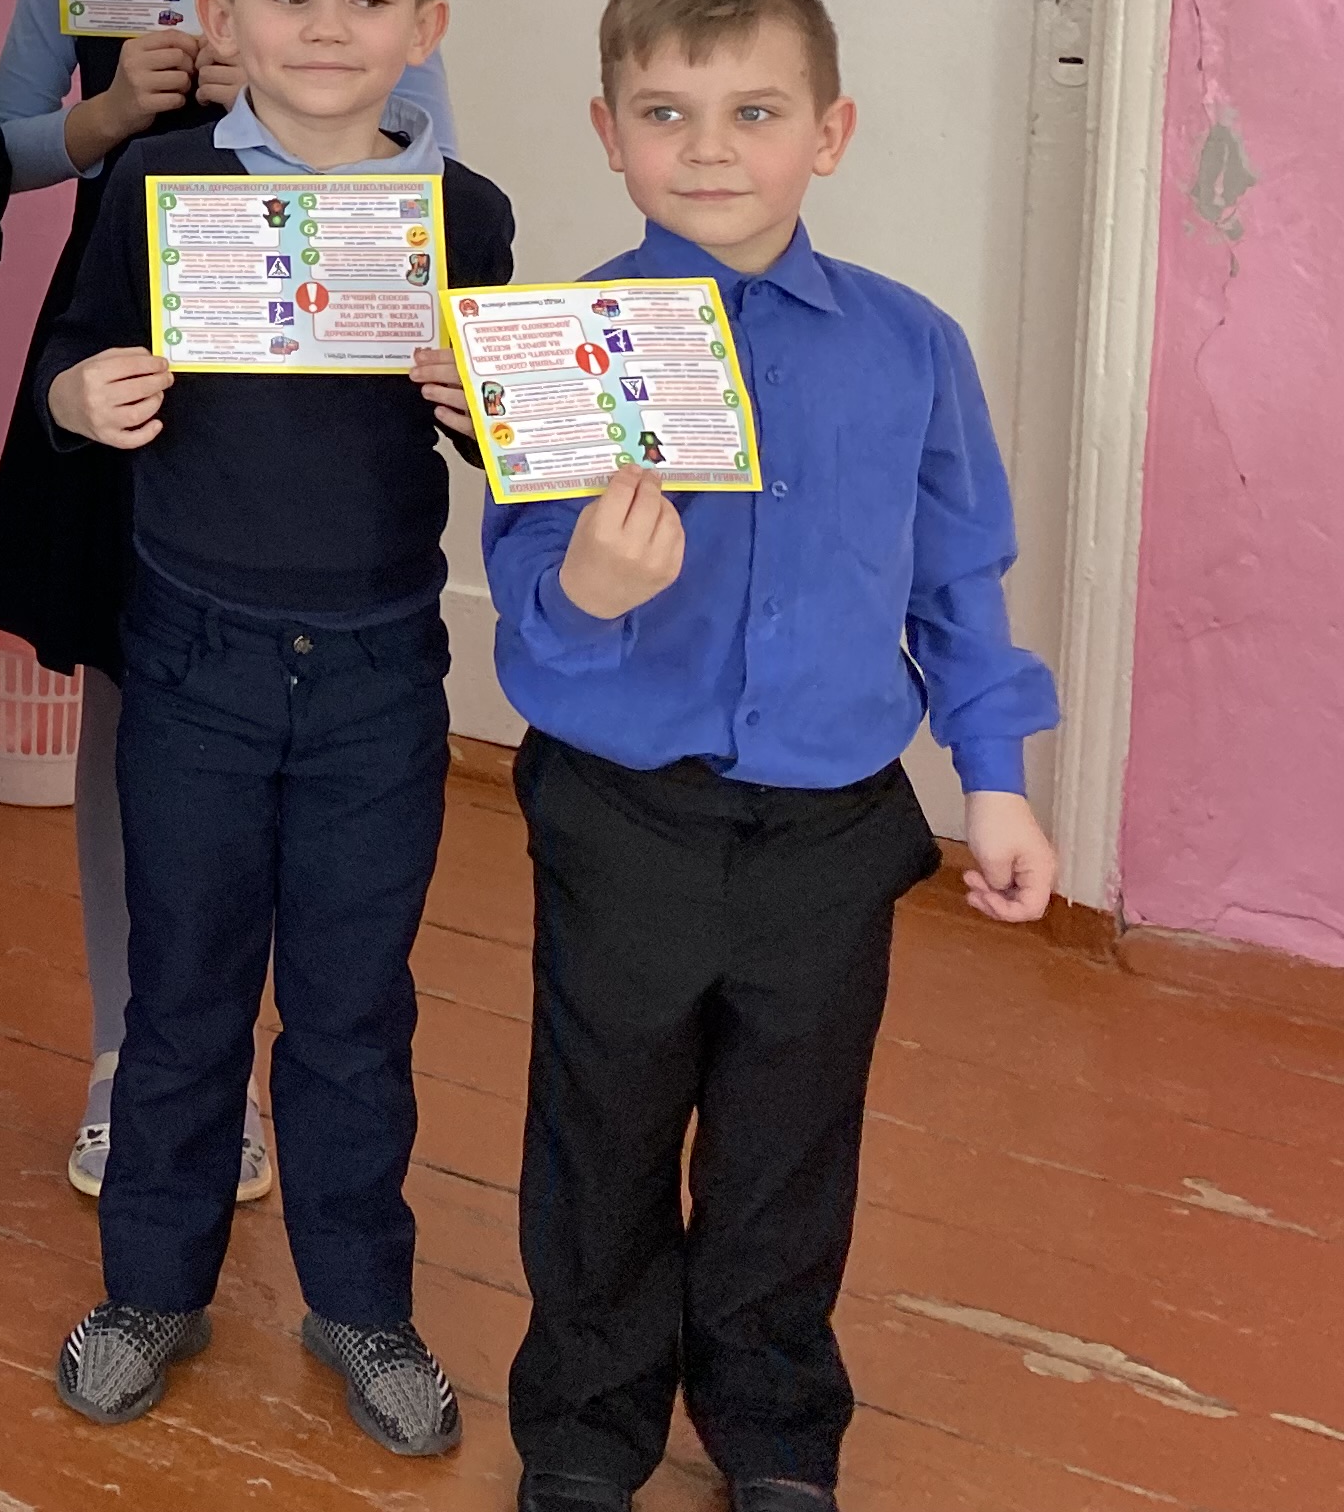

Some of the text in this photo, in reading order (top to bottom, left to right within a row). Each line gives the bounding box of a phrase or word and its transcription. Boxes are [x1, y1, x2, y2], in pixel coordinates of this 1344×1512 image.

[72, 5, 82, 13] 4
[163, 196, 172, 207] 1
[302, 196, 313, 207] 5
[303, 223, 314, 233] 6
[166, 252, 176, 261] 2
[305, 252, 316, 262] 7
[166, 297, 177, 307] 3
[701, 308, 713, 320] 4
[167, 332, 180, 343] 4
[713, 344, 724, 356] 3
[601, 397, 613, 409] 7
[725, 392, 737, 405] 2
[610, 427, 622, 439] 6
[737, 455, 747, 468] 1
